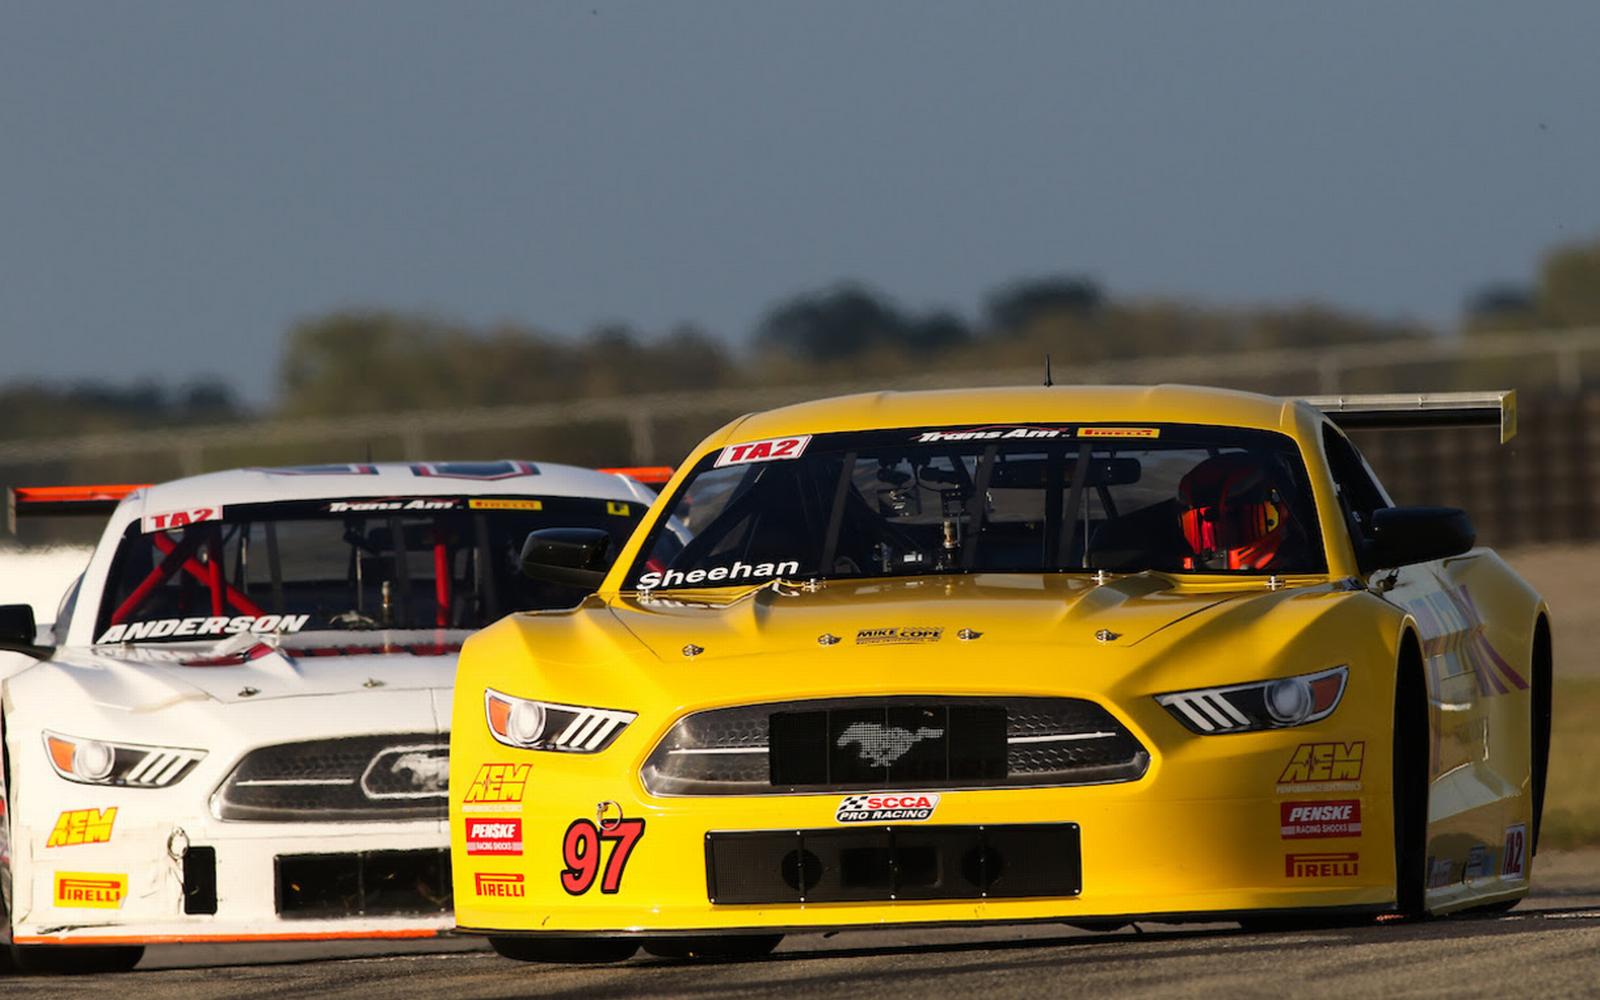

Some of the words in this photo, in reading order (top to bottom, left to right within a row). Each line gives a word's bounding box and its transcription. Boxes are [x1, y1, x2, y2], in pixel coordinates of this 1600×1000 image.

[918, 430, 1002, 442] Trans
[1002, 428, 1060, 439] Am
[730, 439, 799, 462] TA2
[329, 500, 402, 512] Trans
[404, 500, 454, 511] Am
[152, 508, 214, 528] TA2
[636, 560, 799, 590] Sheehan
[95, 614, 310, 645] ANDERSON
[857, 628, 897, 638] MIKE
[900, 630, 940, 638] COPE
[1277, 741, 1365, 784] AEM
[463, 763, 533, 803] AEM
[840, 811, 869, 820] PRO
[871, 809, 929, 820] RACING
[868, 797, 931, 809] SCCA
[1289, 805, 1353, 822] PENSKE
[46, 806, 118, 848] AEM
[470, 823, 517, 839] PENSKE
[561, 817, 646, 896] 97
[1285, 852, 1359, 877] PIRELLI
[60, 879, 120, 902] PIRELLI
[475, 872, 525, 897] PIRELLI
